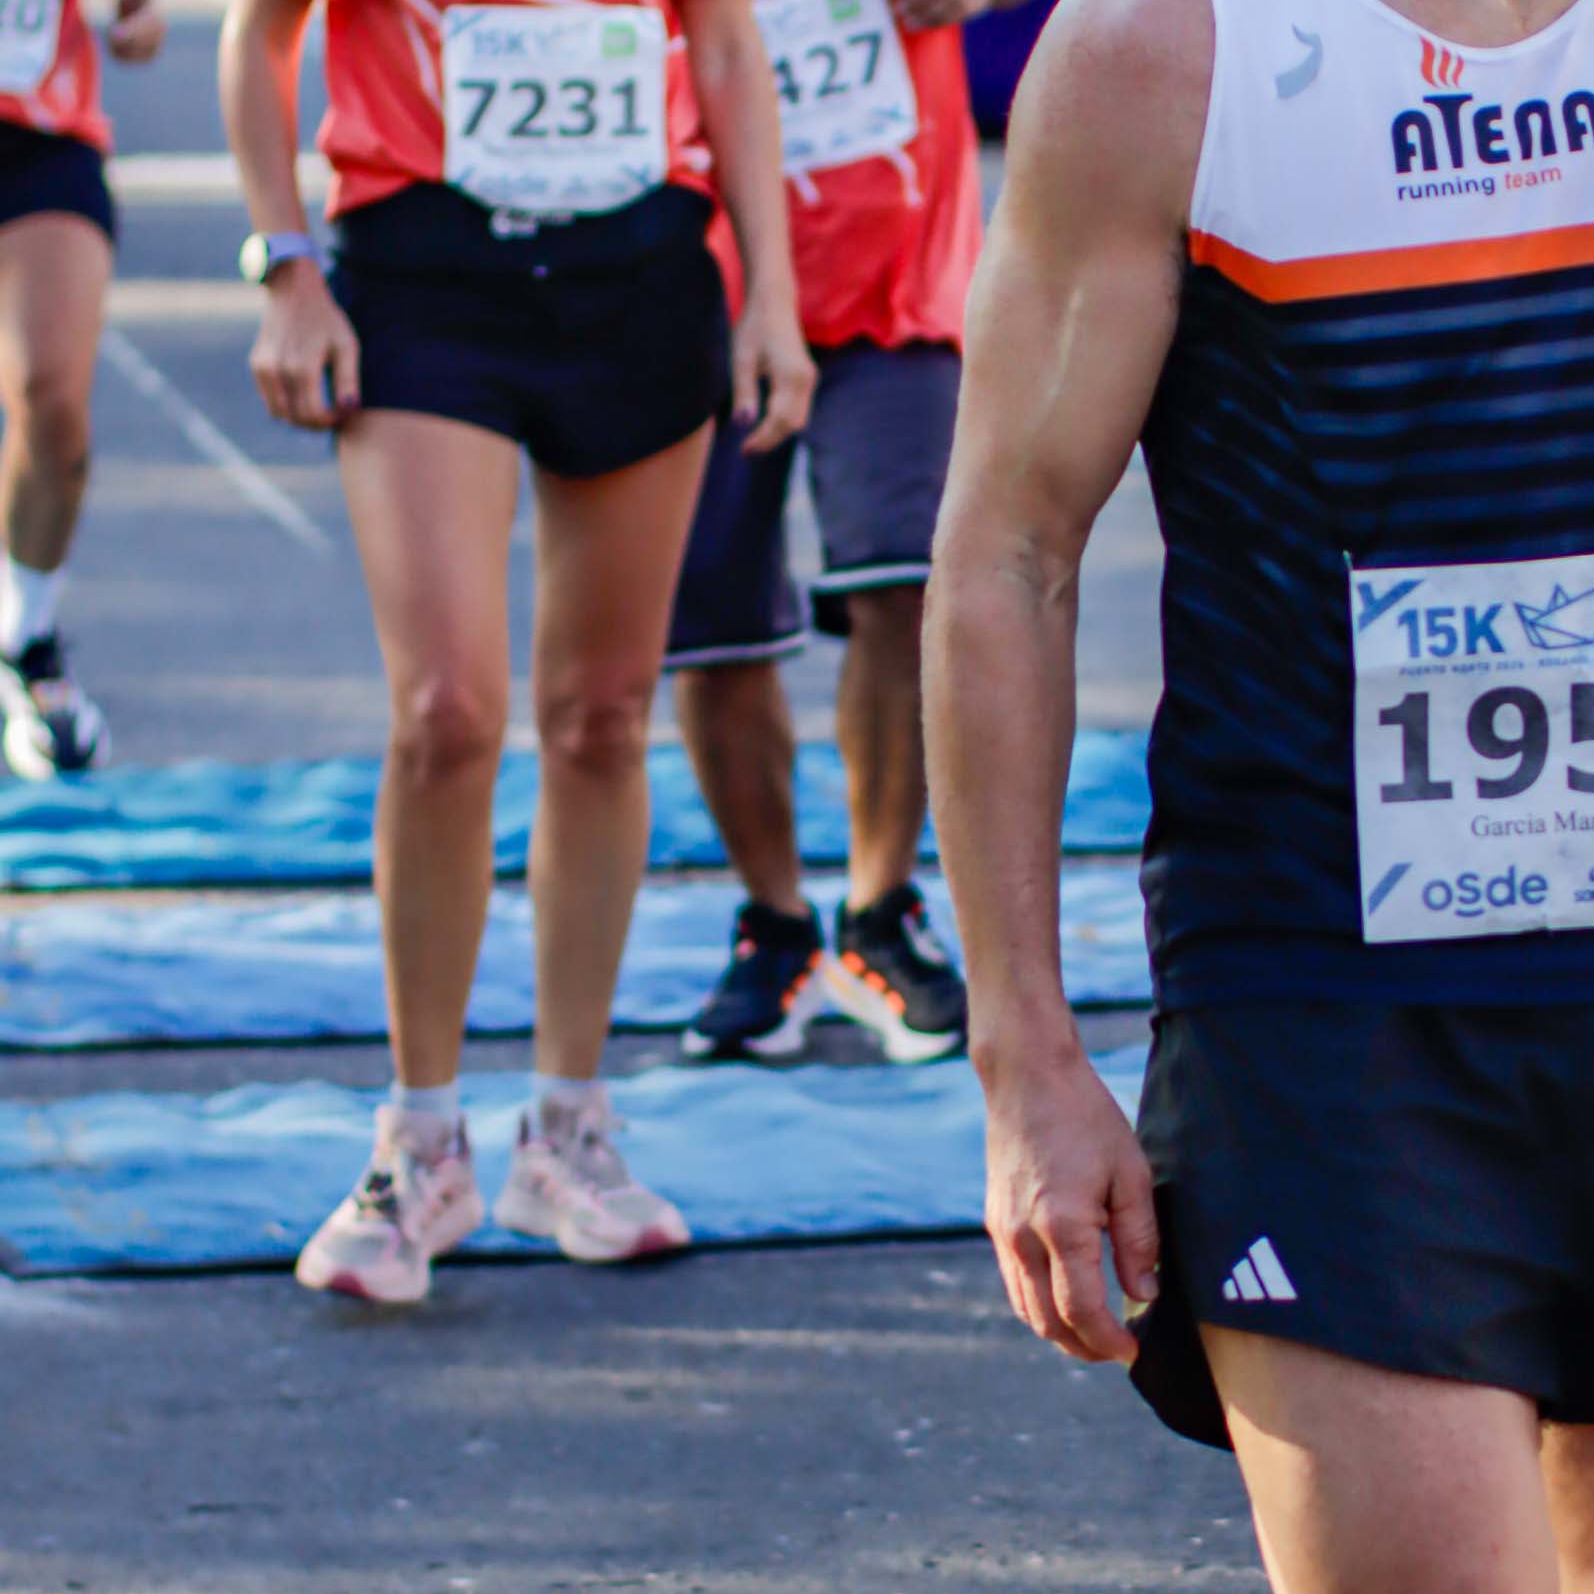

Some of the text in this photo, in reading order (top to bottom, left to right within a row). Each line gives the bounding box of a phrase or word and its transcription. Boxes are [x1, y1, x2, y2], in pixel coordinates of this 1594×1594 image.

[773, 31, 883, 104] 427
[457, 77, 649, 138] 7231
[1397, 167, 1562, 201] running team
[1397, 603, 1505, 659] 15K
[1422, 864, 1549, 917] osde
